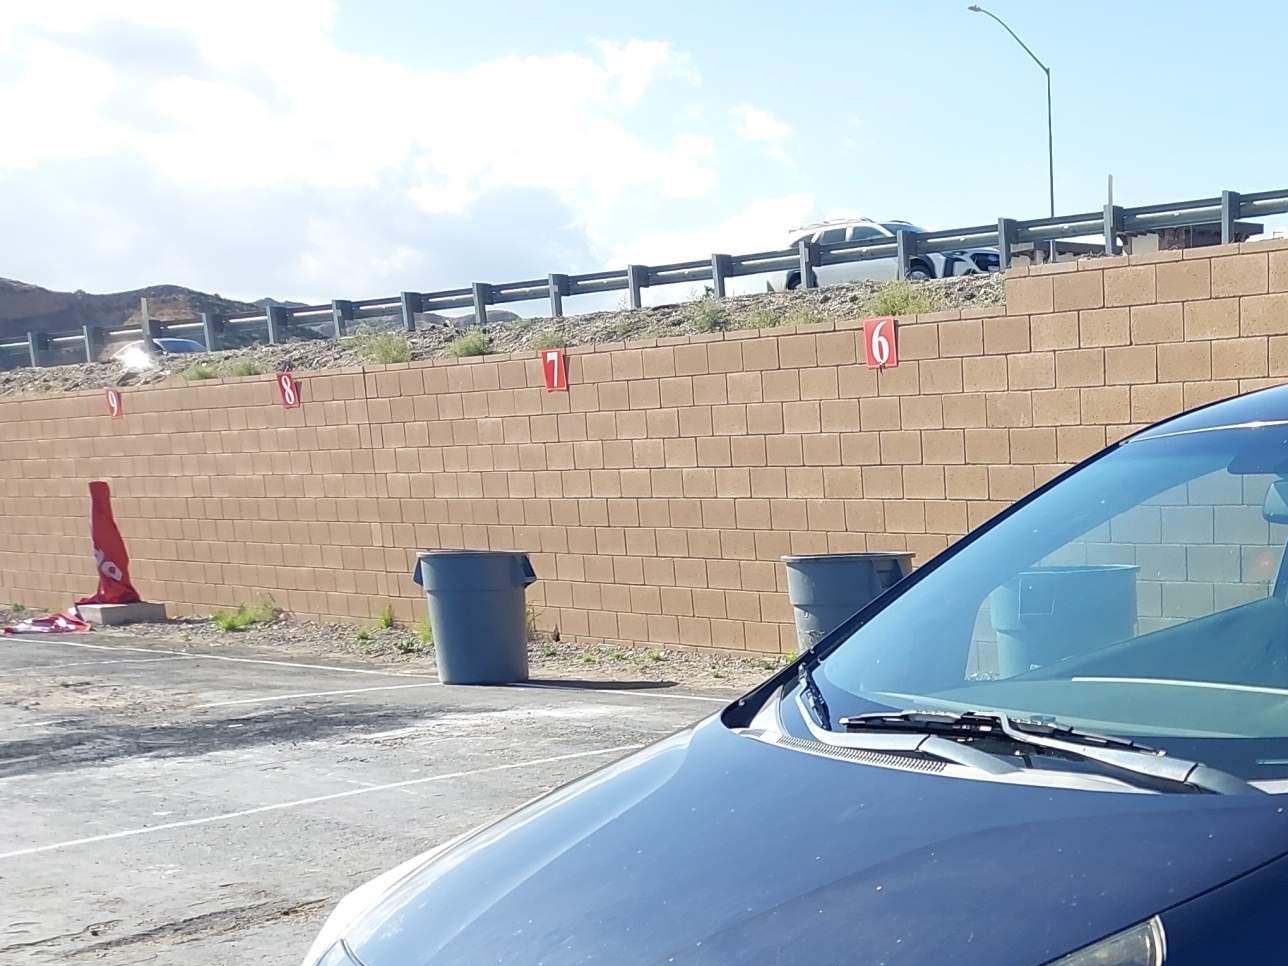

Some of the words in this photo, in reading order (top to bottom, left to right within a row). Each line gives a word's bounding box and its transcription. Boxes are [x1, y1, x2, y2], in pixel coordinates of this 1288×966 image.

[871, 320, 889, 364] 6
[546, 351, 558, 388] 7
[108, 390, 118, 417] 9
[281, 375, 295, 405] 8
